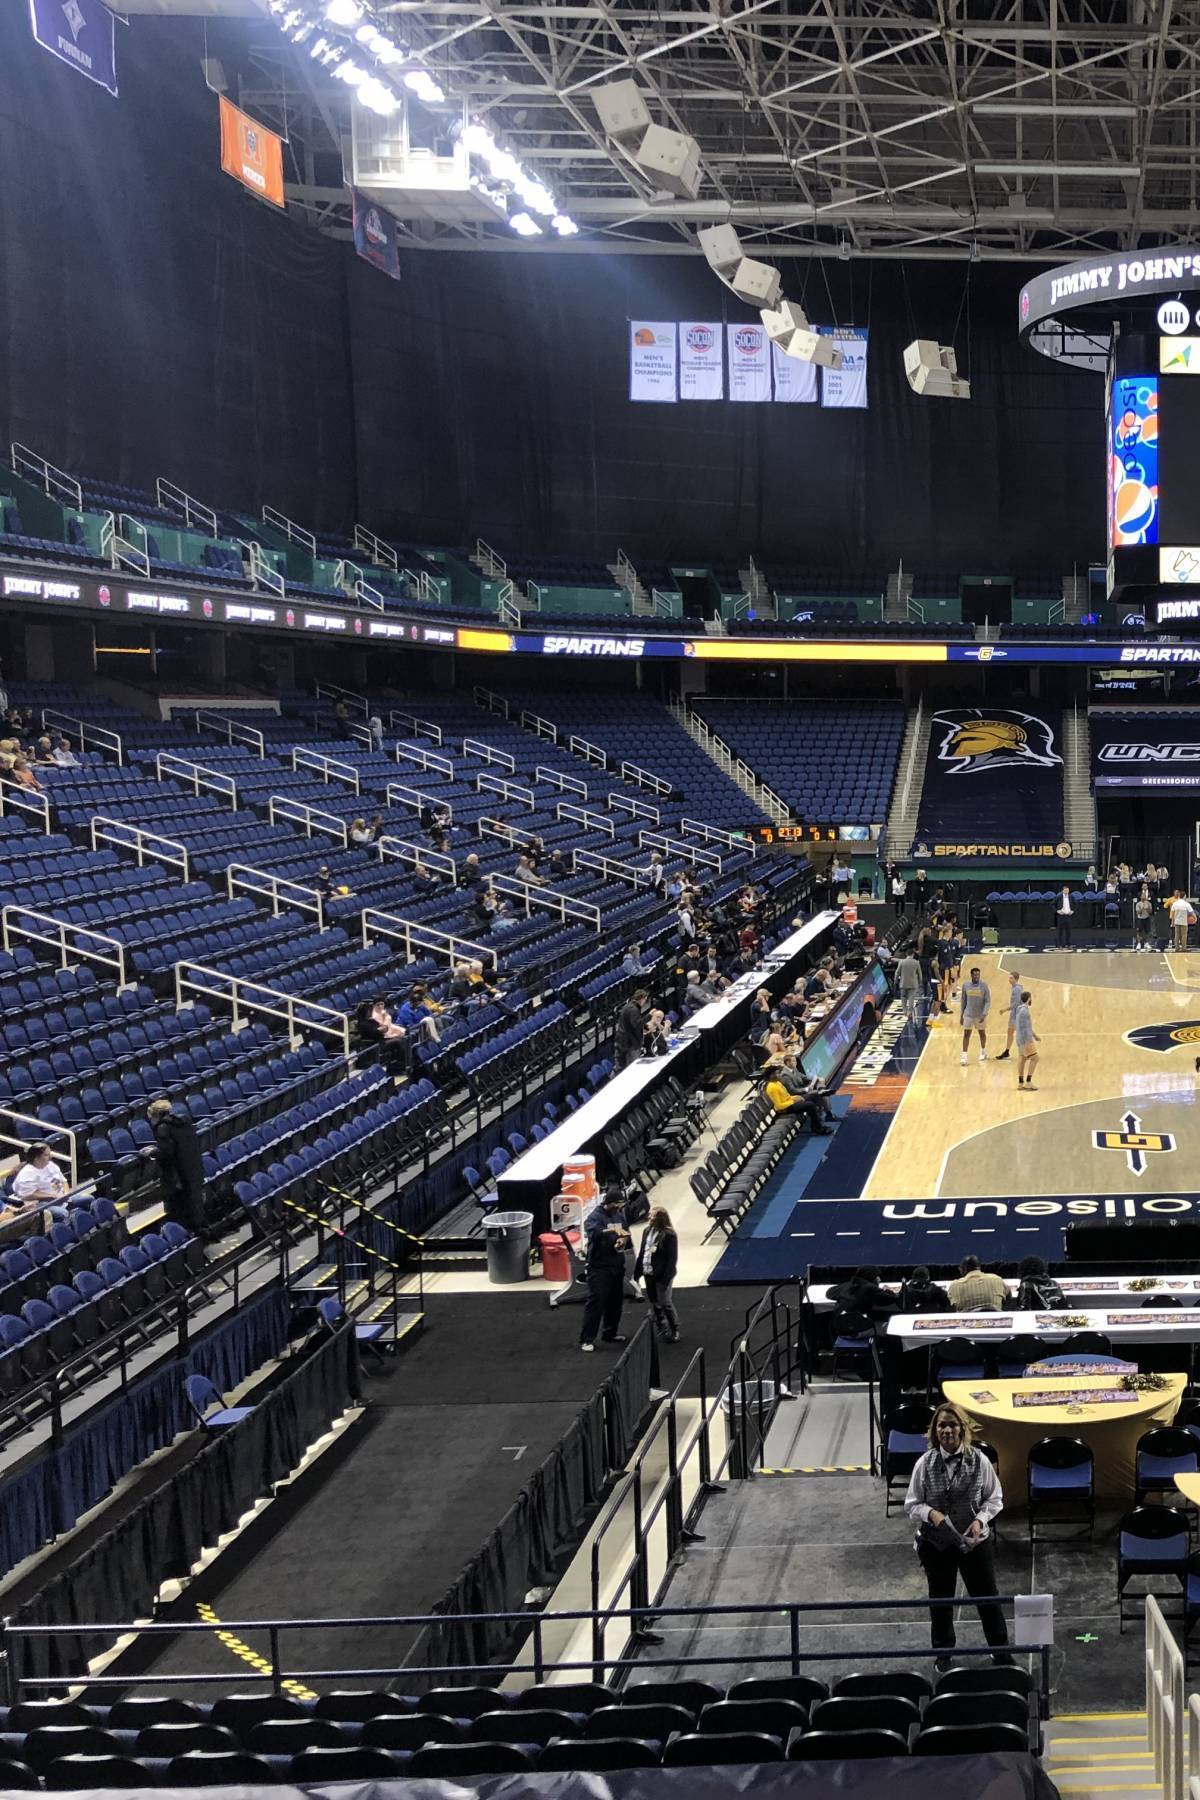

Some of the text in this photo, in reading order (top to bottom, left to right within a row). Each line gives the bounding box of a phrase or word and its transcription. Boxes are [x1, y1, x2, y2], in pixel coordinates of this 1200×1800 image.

[1051, 266, 1113, 305] JIMMY
[687, 331, 713, 346] SOCON
[735, 333, 761, 347] SOCON
[1120, 384, 1142, 474] pepsi
[543, 636, 645, 656] SPARTANS
[934, 845, 1008, 856] SPARTAN
[1011, 845, 1054, 856] CLUB
[561, 1203, 570, 1213] G
